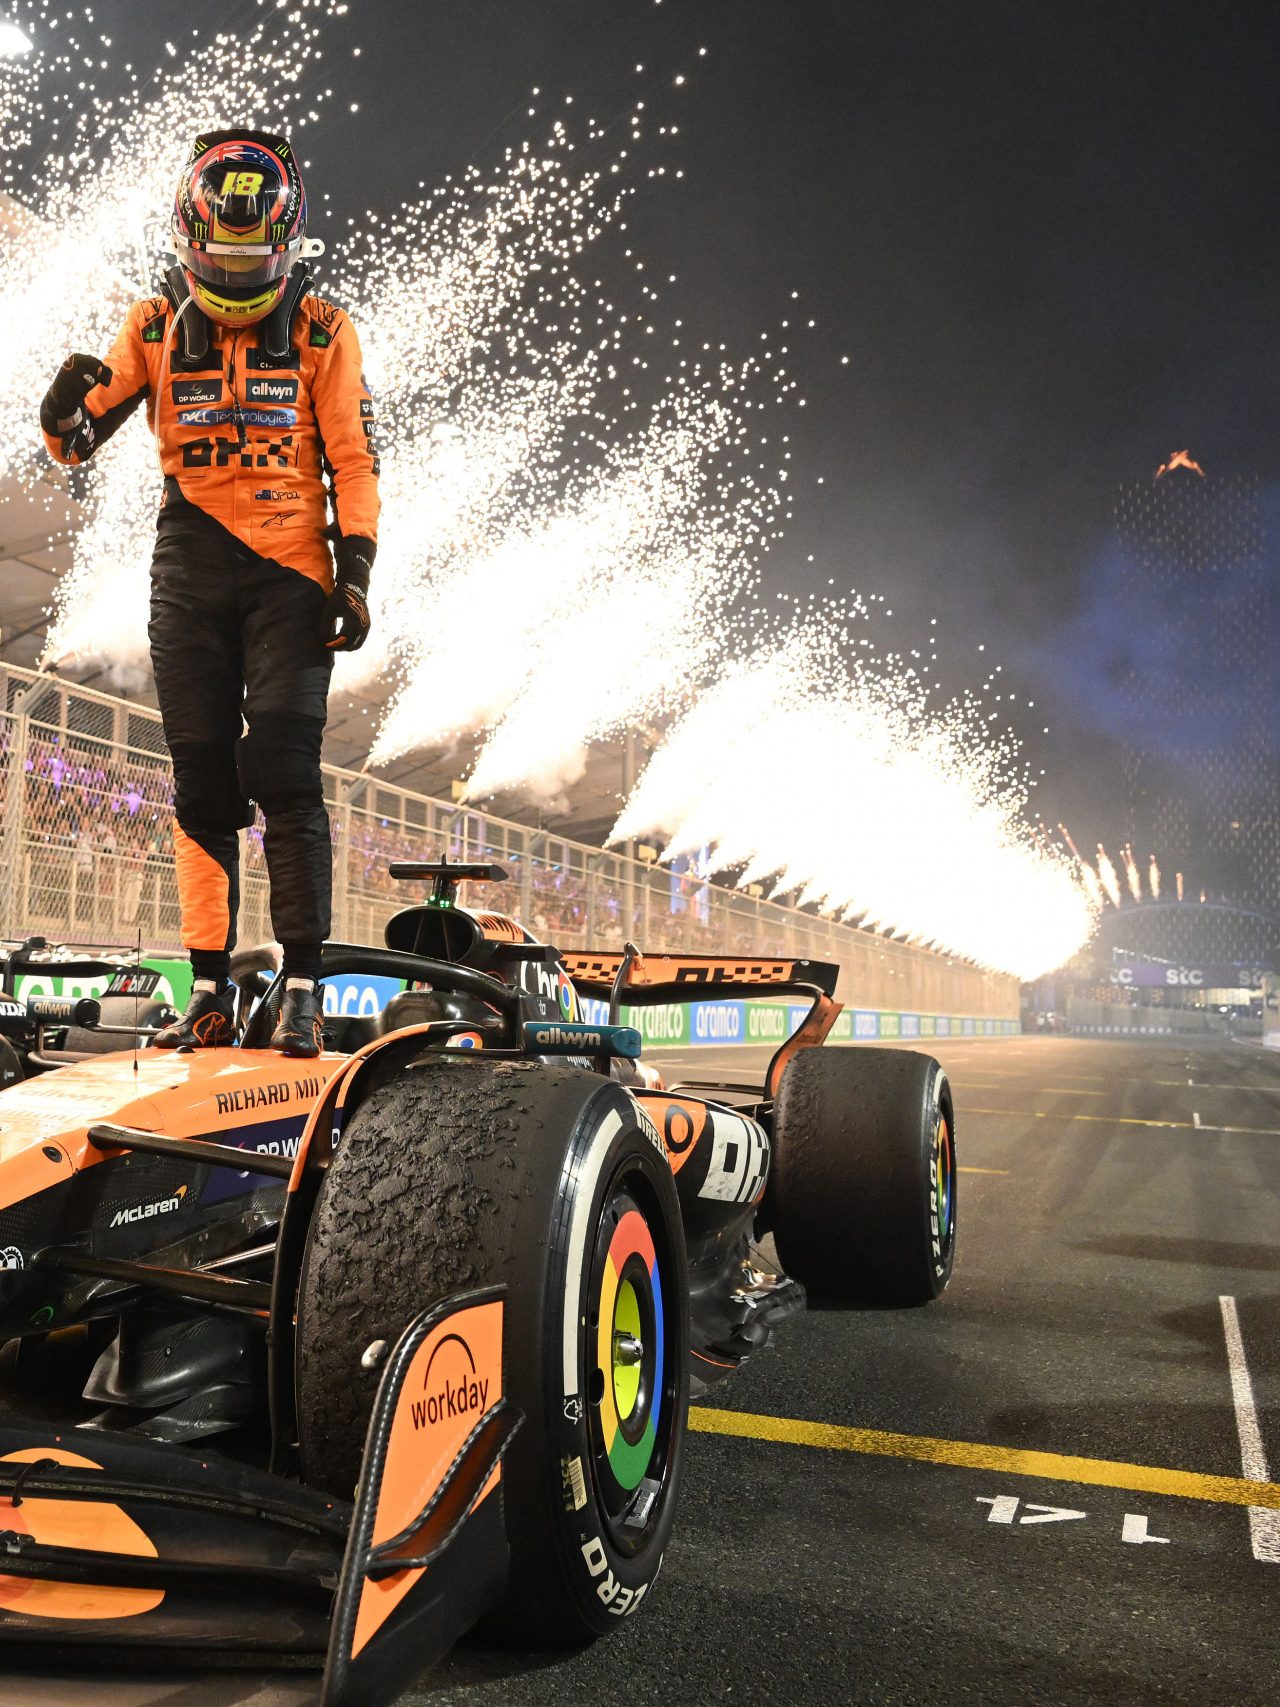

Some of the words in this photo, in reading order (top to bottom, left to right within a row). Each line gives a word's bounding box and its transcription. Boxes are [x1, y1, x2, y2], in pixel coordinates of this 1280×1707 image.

[251, 382, 293, 400] allwyn
[108, 973, 144, 993] Mobil
[33, 1000, 71, 1018] allwyn
[628, 1003, 684, 1038] aramco
[696, 1005, 739, 1038] aramco
[749, 1008, 784, 1037] aramco
[536, 1027, 601, 1049] allwyn
[215, 1082, 291, 1115] RICHARD
[109, 1197, 179, 1229] McLaren
[929, 1158, 943, 1259] ZERO
[411, 1376, 490, 1431] workday
[581, 1536, 649, 1618] ZERO
